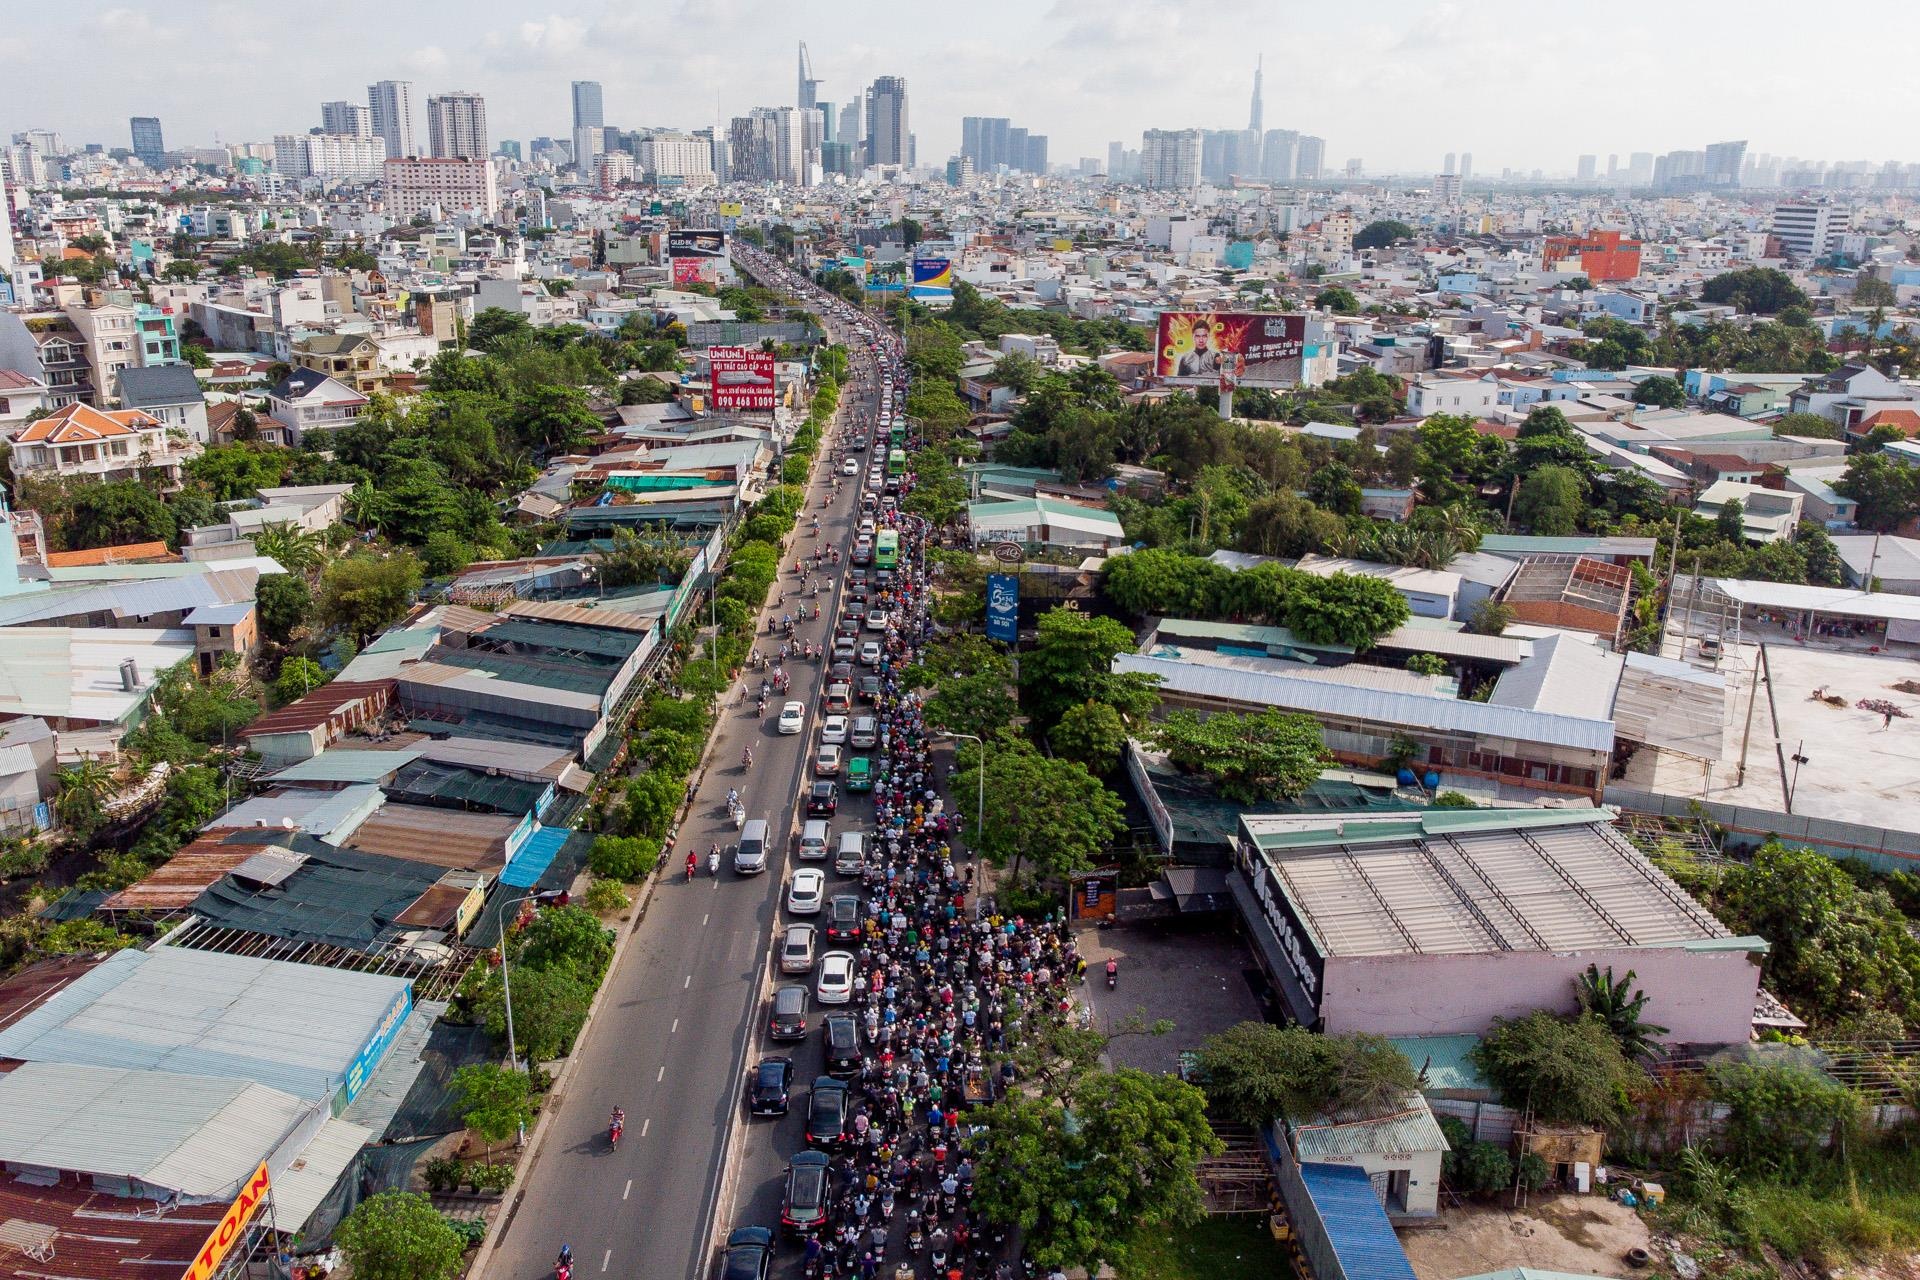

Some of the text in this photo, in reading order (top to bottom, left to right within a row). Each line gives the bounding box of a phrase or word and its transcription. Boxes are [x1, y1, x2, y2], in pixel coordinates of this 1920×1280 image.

[749, 361, 759, 369] CẤP
[718, 396, 772, 406] 090 468 1009
[1063, 600, 1078, 610] AQ
